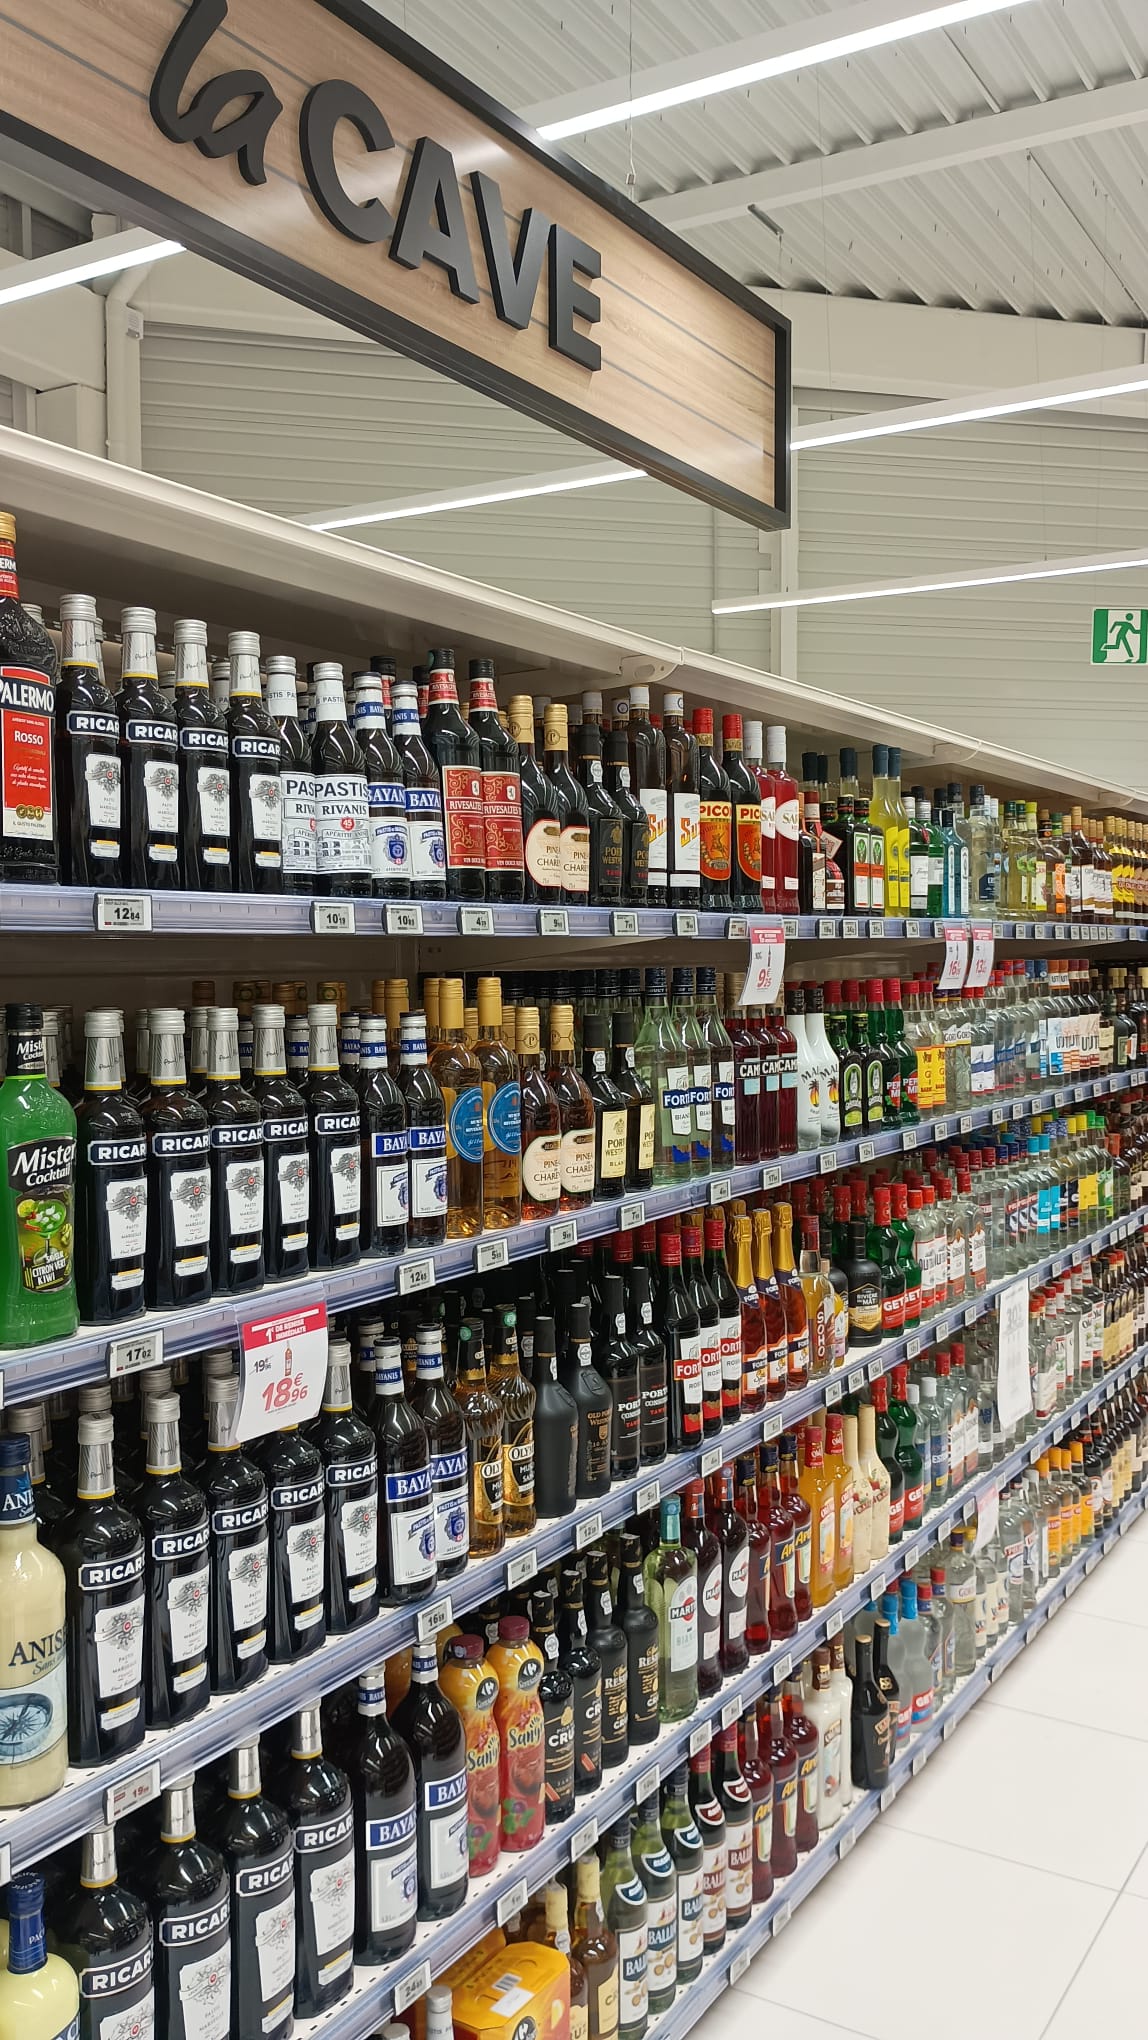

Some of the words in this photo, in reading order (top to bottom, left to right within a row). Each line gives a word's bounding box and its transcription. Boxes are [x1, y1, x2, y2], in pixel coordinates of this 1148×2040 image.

[150, 0, 283, 186] la
[299, 78, 602, 371] CAVE
[0, 681, 54, 713] ALERMO
[14, 730, 43, 745] ROSSO
[322, 801, 367, 815] RIVANIS
[12, 1142, 76, 1177] Mister
[26, 1164, 71, 1187] Cocktail
[32, 1263, 54, 1277] CITRON
[37, 1272, 56, 1286] KIWI
[276, 1325, 284, 1333] DE
